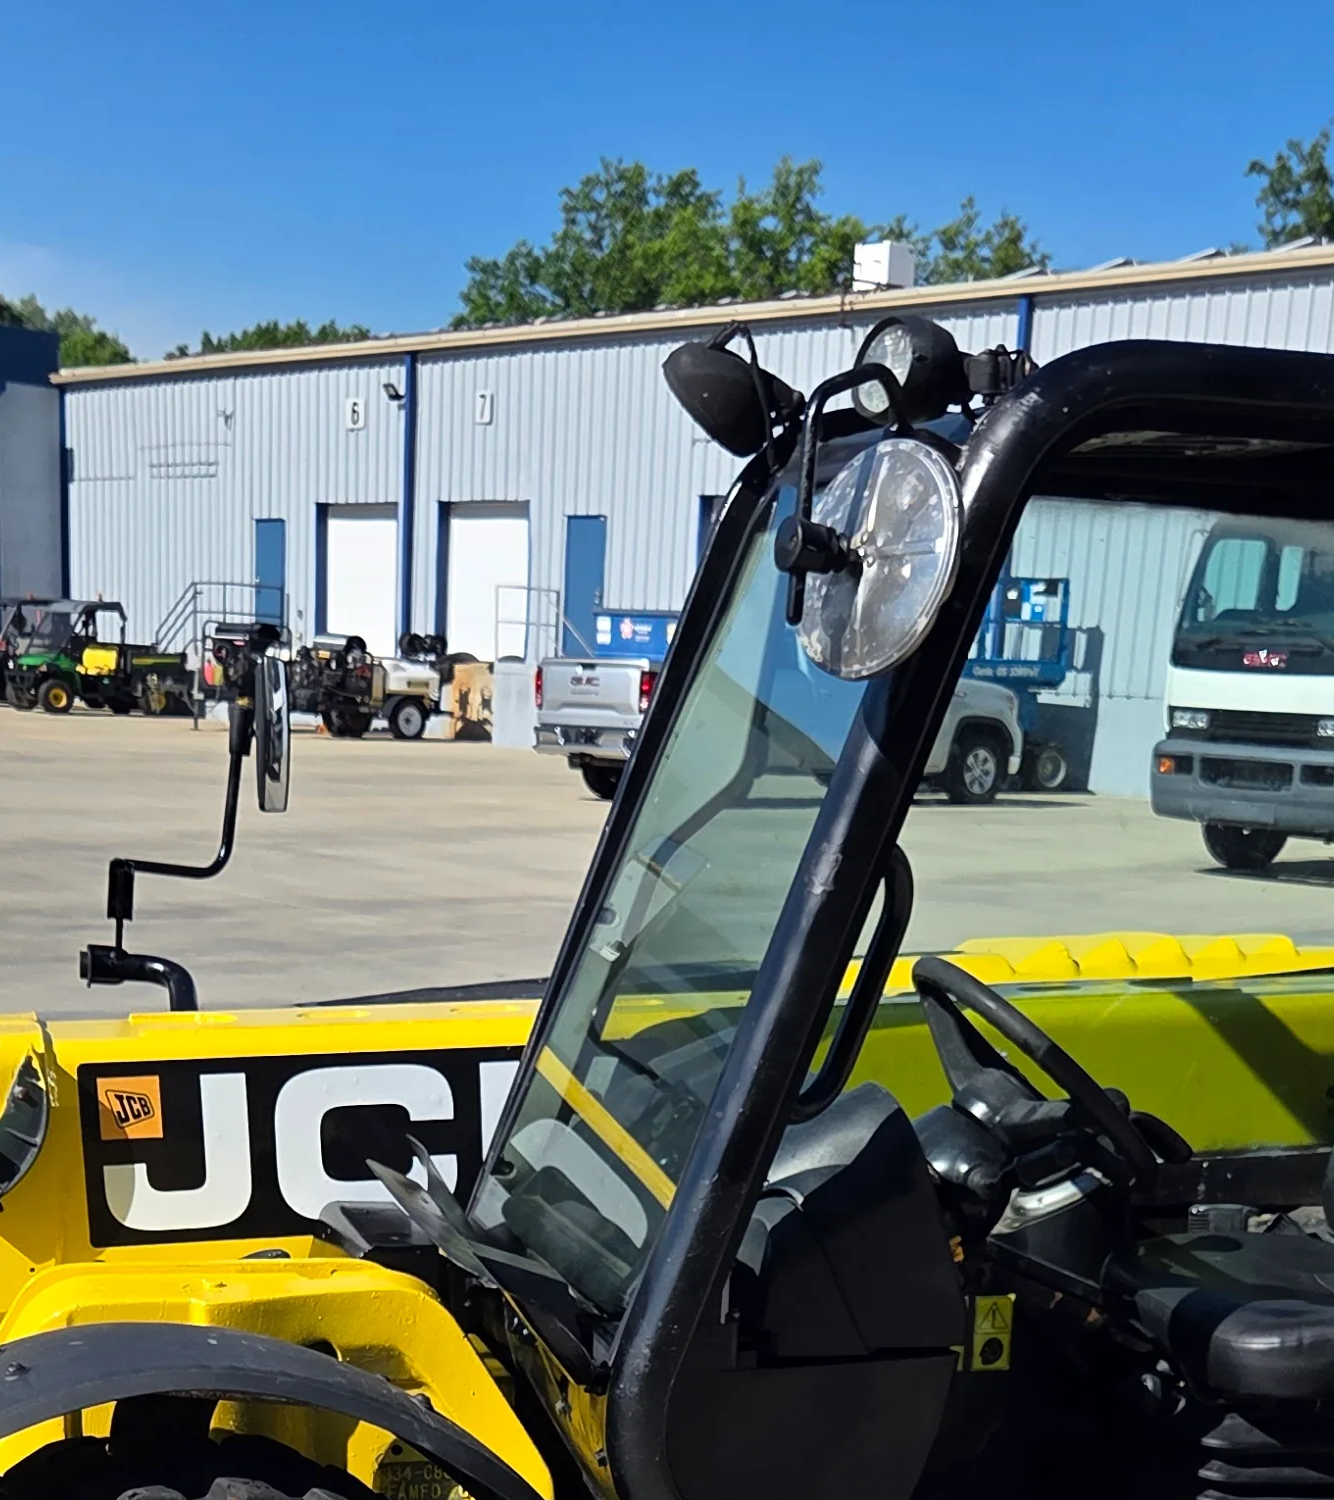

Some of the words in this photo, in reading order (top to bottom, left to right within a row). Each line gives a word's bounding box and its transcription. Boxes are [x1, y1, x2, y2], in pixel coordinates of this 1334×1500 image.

[350, 402, 360, 426] 6
[478, 393, 488, 420] 7
[114, 1093, 152, 1125] JCB
